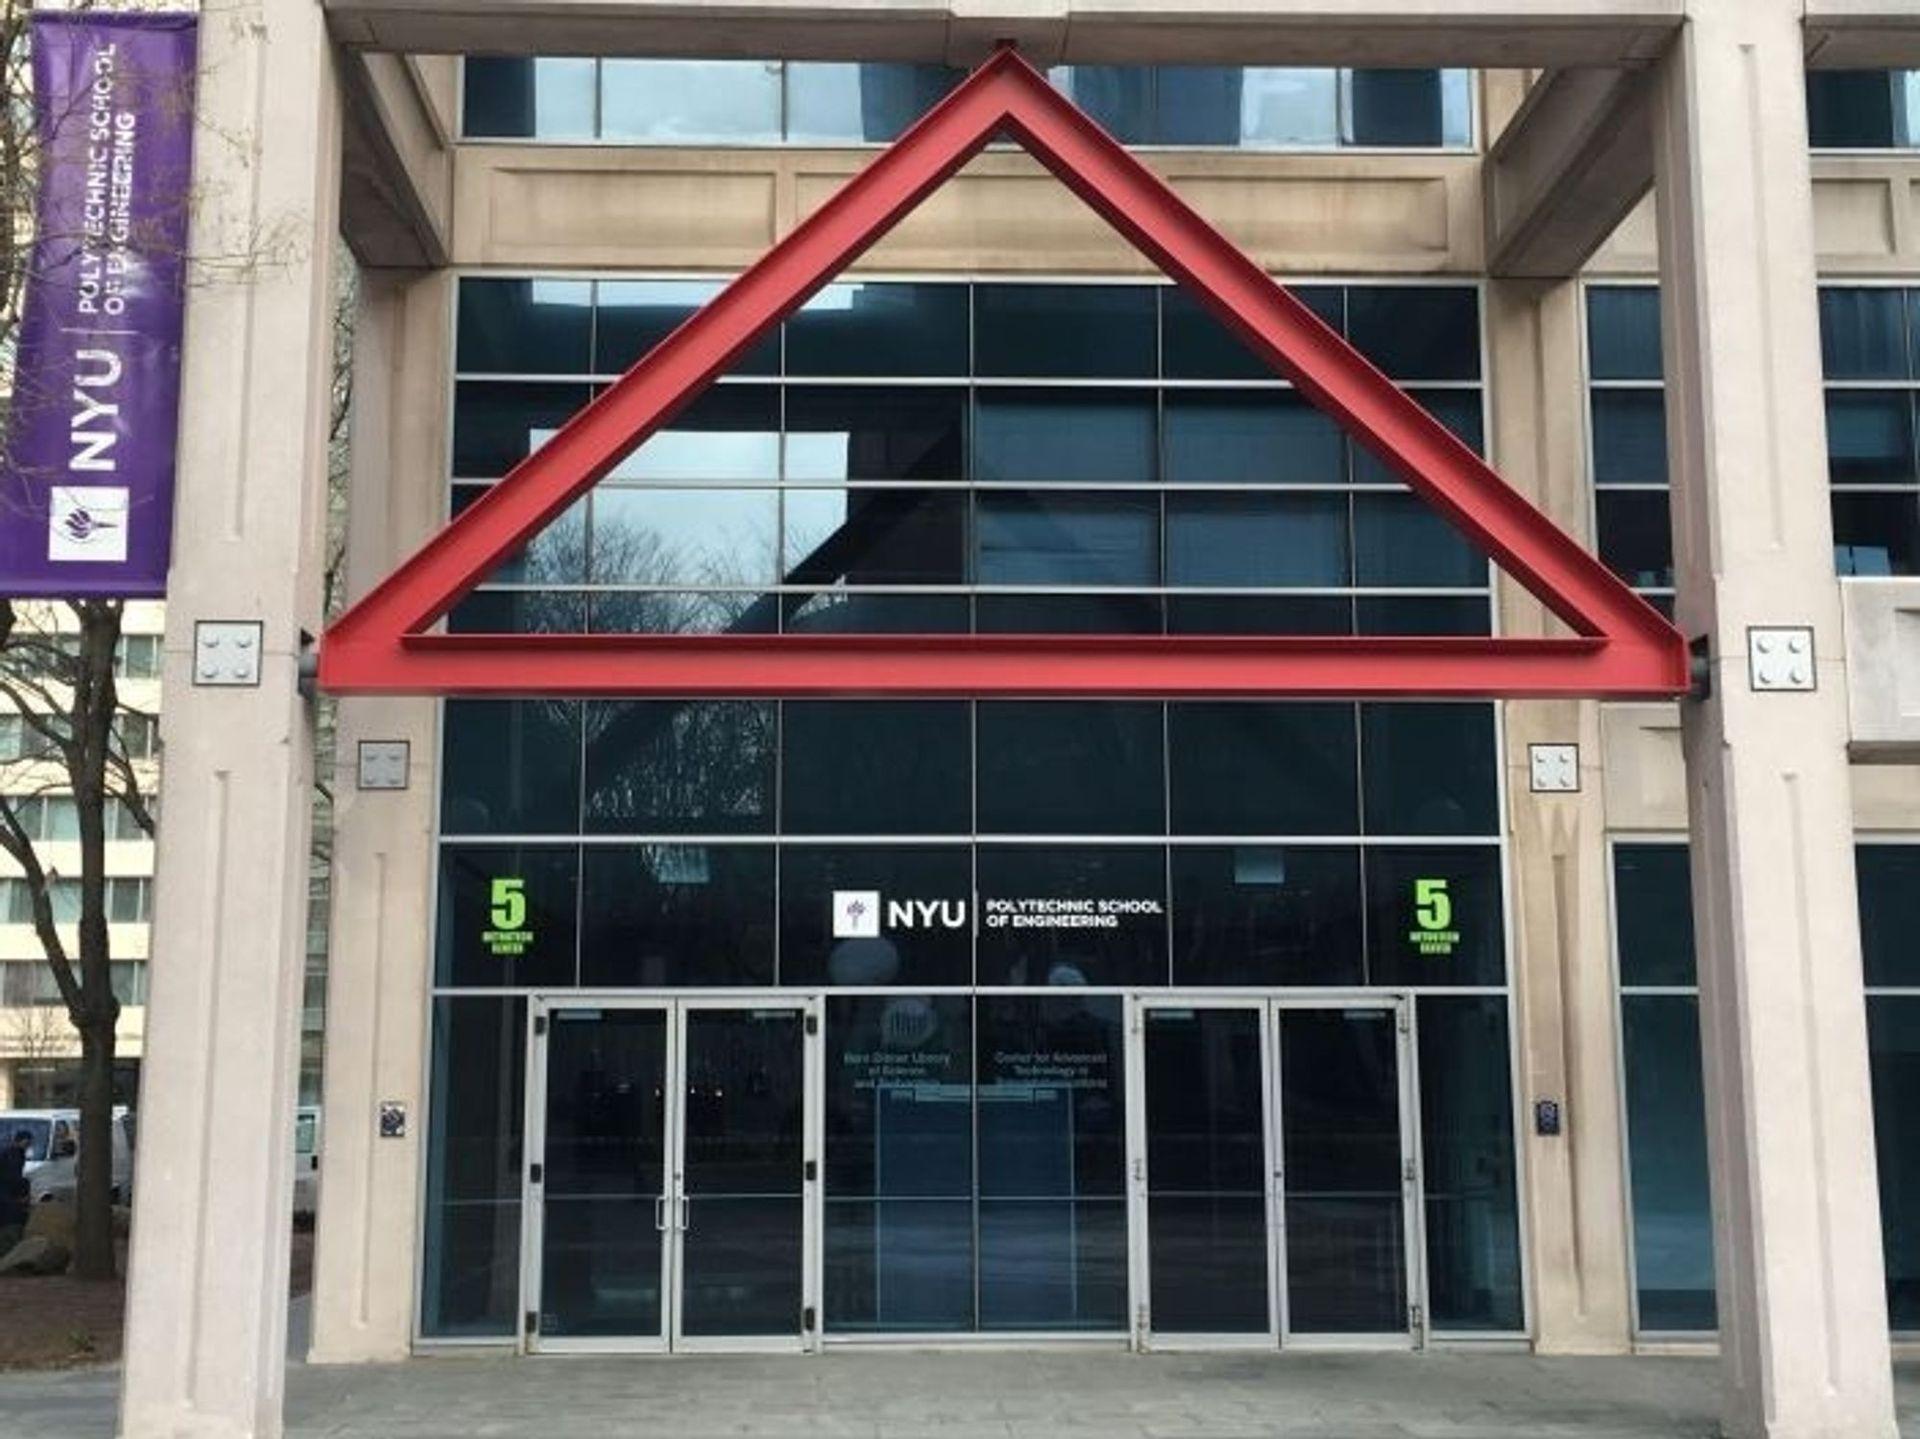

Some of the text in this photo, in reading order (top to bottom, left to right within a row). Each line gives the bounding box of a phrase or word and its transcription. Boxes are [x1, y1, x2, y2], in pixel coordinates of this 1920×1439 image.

[91, 43, 117, 141] SCHOOL
[69, 348, 122, 471] NYU
[491, 879, 525, 930] 5
[888, 899, 967, 928] NYU
[986, 899, 1164, 914] POLYTECHNIC SCHOOL
[986, 914, 1119, 928] OF ENGINEERING
[1416, 879, 1450, 930] 5
